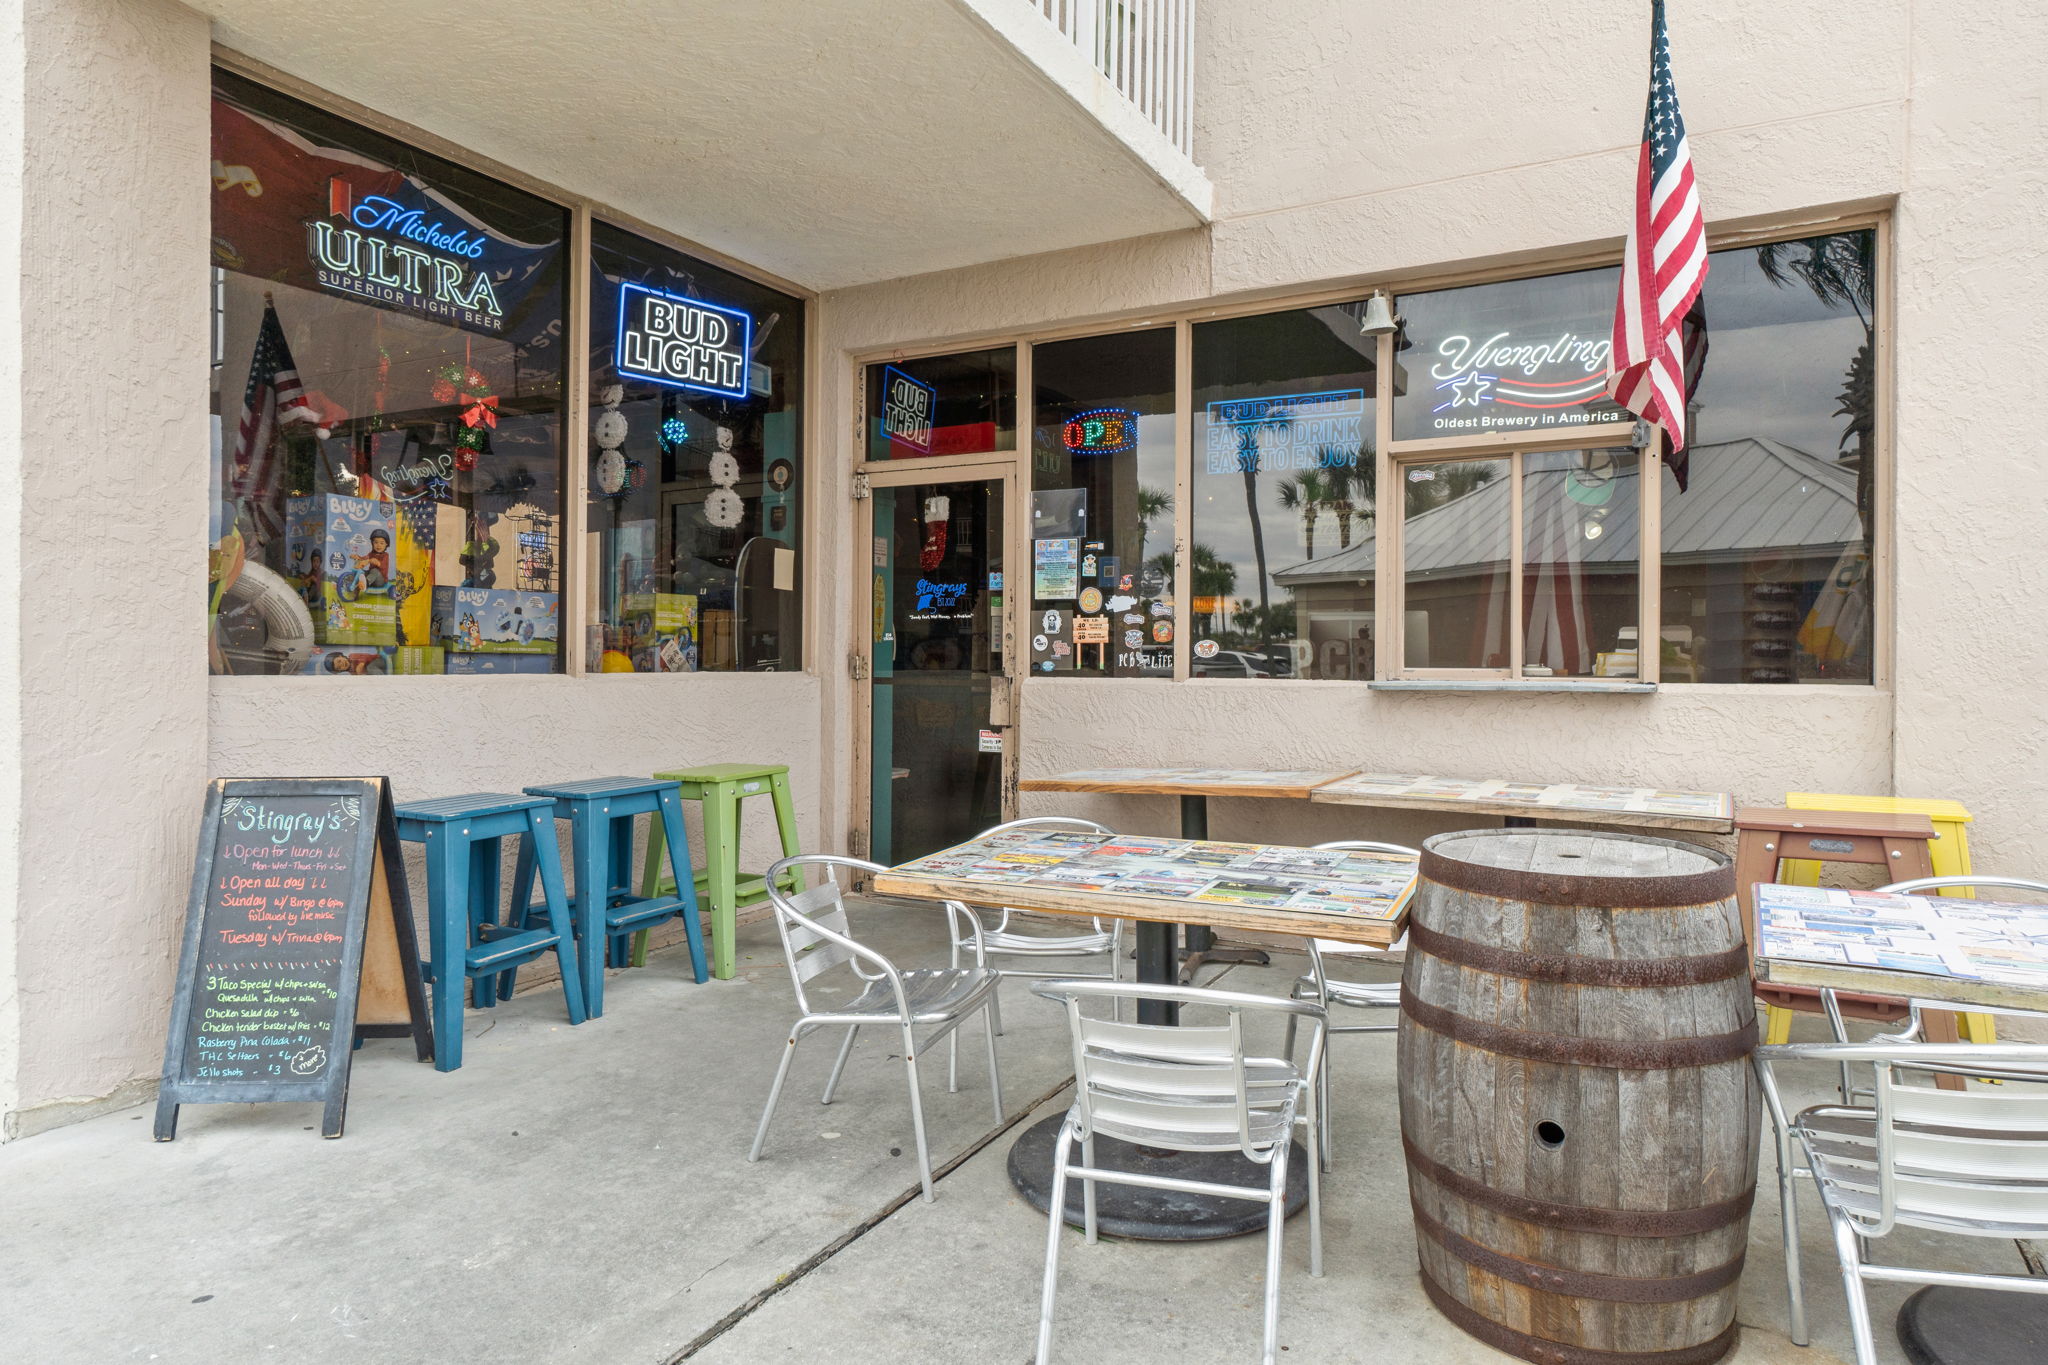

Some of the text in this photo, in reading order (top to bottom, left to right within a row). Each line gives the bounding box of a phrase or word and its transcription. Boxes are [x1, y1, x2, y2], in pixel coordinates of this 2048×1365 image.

[353, 195, 486, 258] Michelob
[314, 221, 503, 317] ULTRA
[318, 270, 502, 330] SUPERIOR LIGHT BEER
[644, 297, 728, 349] BUD
[1431, 332, 1612, 380] Yuengling
[1221, 393, 1349, 421] BUD LIGHT
[1434, 410, 1619, 429] Oldest Brewery in America
[1063, 419, 1140, 448] OPEN
[1207, 417, 1362, 451] EASY TO DRINK
[1207, 442, 1362, 475] EASY TO ENJOY
[915, 579, 967, 598] Stingrays
[237, 805, 341, 843] Stingray's
[233, 844, 323, 864] Open for lunch
[230, 875, 306, 894] Open all day
[220, 893, 267, 911] Sunday
[274, 895, 288, 909] w/
[290, 896, 315, 911] Bingo
[248, 909, 335, 926] followed by live music
[219, 929, 267, 947] Tuesday
[206, 976, 217, 990] 3
[217, 976, 238, 989] Taco
[240, 979, 272, 991] Special
[218, 993, 258, 1003] Quesadilla
[205, 1007, 239, 1018] Chicken
[264, 1009, 279, 1018] dip
[201, 1022, 234, 1032] Chicken
[236, 1022, 262, 1031] tender
[263, 1021, 287, 1030] basket
[297, 1021, 310, 1030] fries
[197, 1036, 236, 1050] Rasberry
[261, 1035, 290, 1046] Colada
[199, 1051, 223, 1060] THC
[196, 1066, 220, 1077] Jello
[222, 1067, 243, 1076] shots
